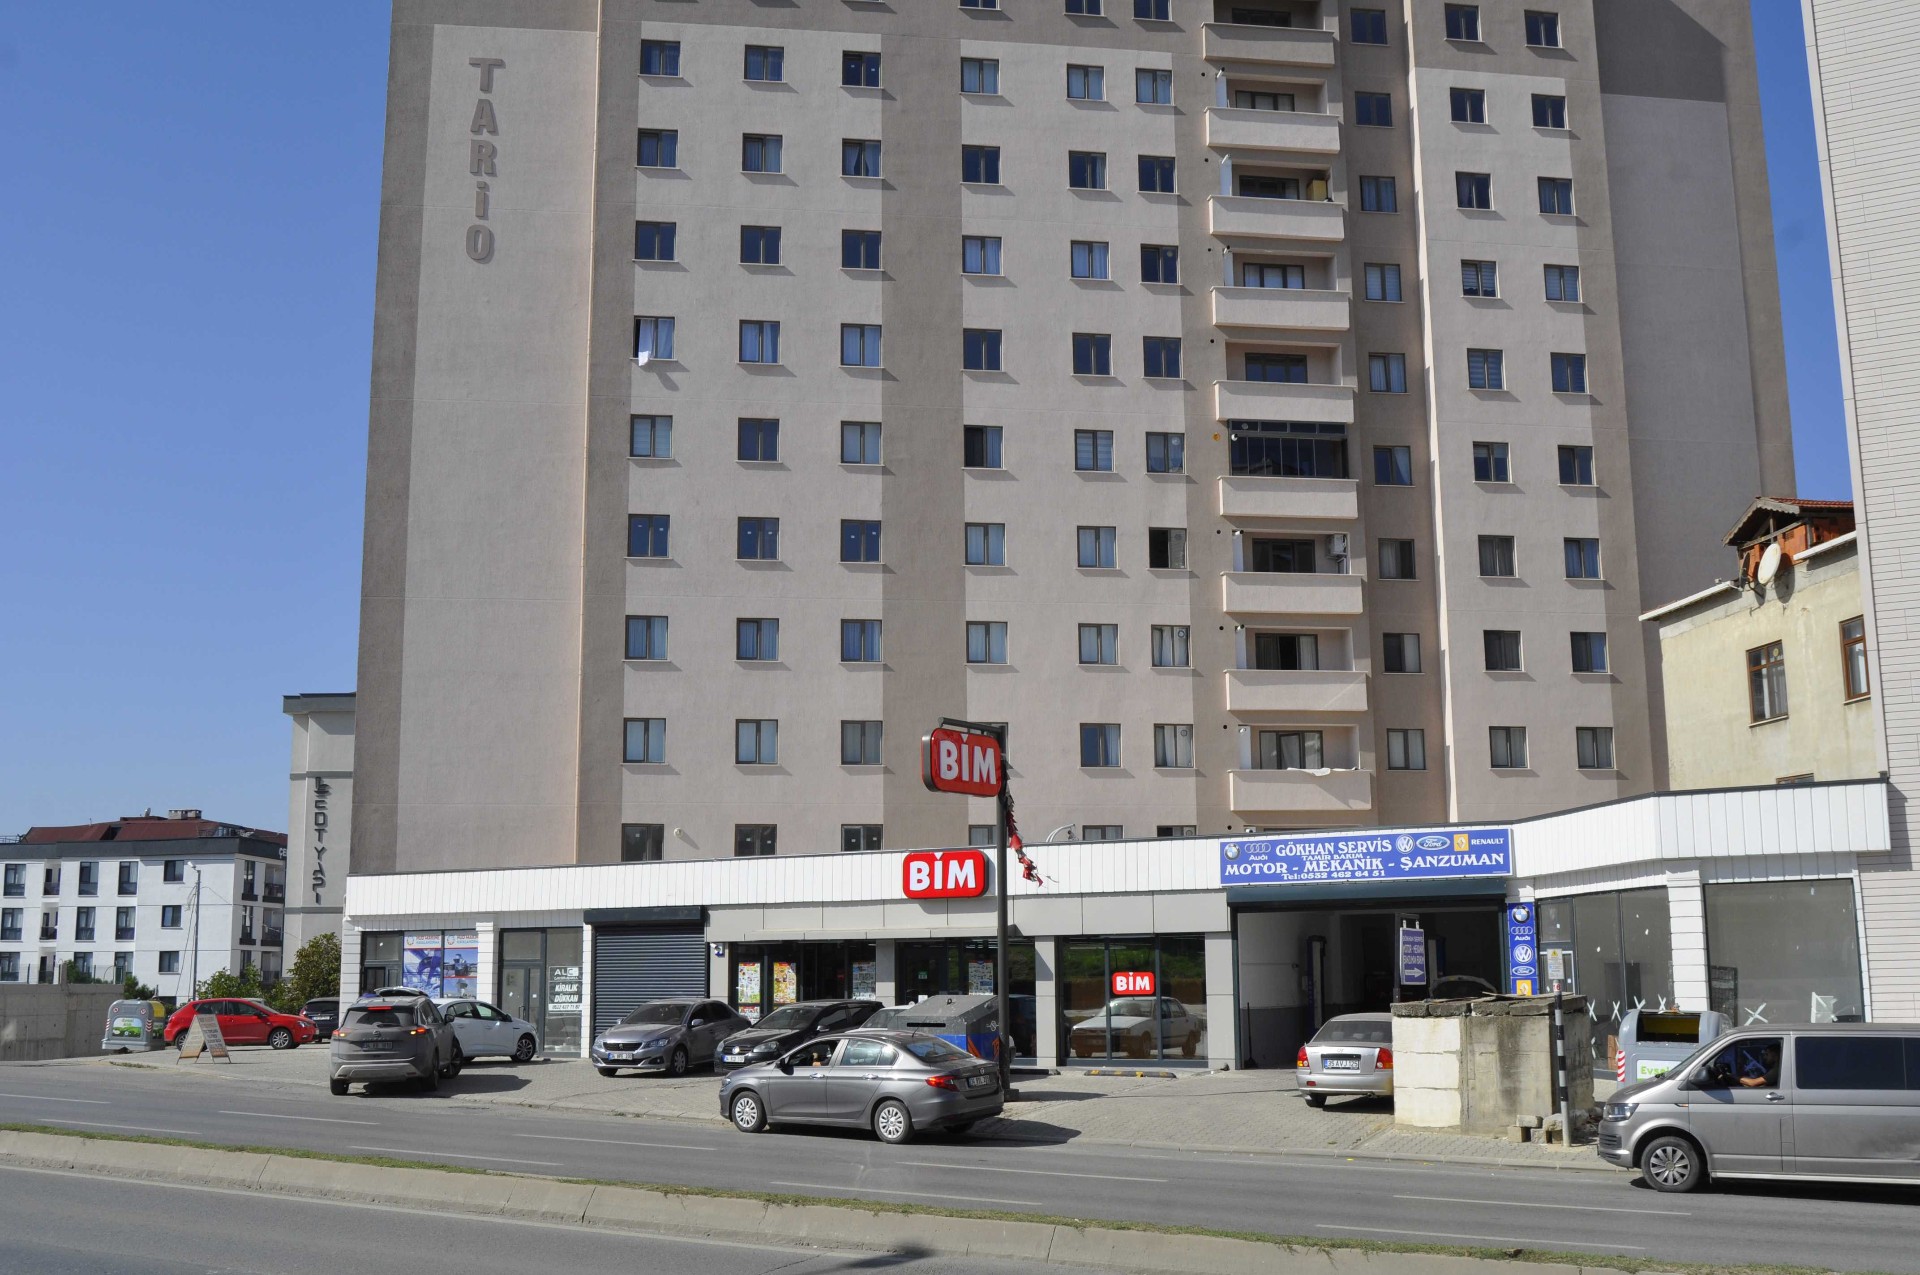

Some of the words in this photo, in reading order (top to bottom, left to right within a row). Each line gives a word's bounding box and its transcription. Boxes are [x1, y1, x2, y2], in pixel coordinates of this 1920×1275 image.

[939, 733, 997, 785] BİM
[1275, 841, 1335, 857] GÖKHAN
[1337, 837, 1393, 854] SERVİS
[1423, 838, 1443, 848] Ford
[1471, 838, 1504, 846] RENAULT
[1224, 862, 1288, 876] MOTOR
[1303, 856, 1384, 873] MEKANİK
[1400, 853, 1504, 872] ŞANZUMAN
[1301, 853, 1331, 861] TAMİR
[909, 852, 976, 891] BİM
[1116, 972, 1151, 991] BİM
[554, 994, 579, 1003] DÜKKAN
